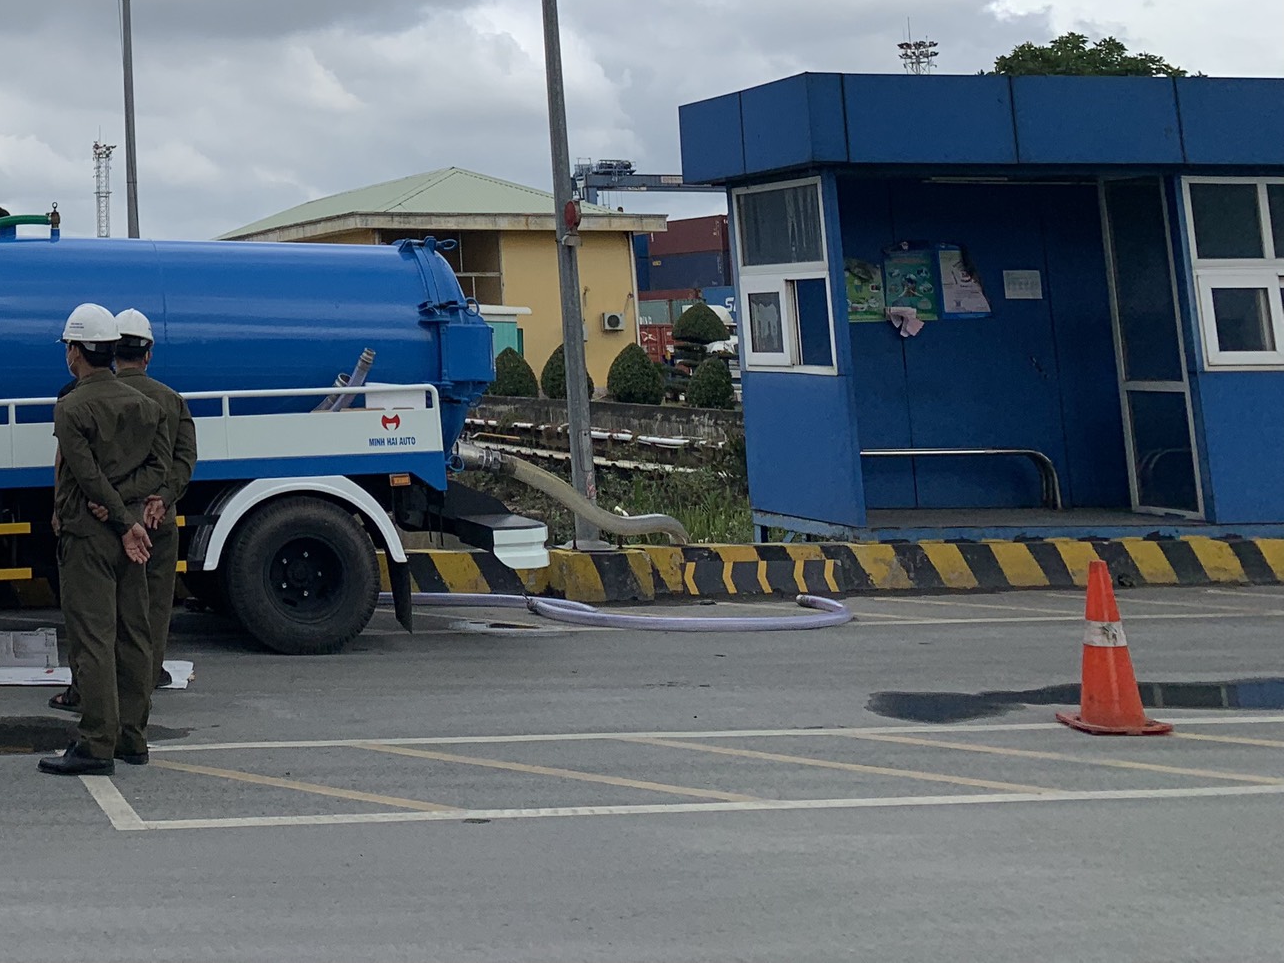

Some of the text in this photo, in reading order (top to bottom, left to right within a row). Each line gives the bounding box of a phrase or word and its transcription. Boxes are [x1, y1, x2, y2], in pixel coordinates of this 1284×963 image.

[368, 436, 416, 447] MINH HAI AUTO
